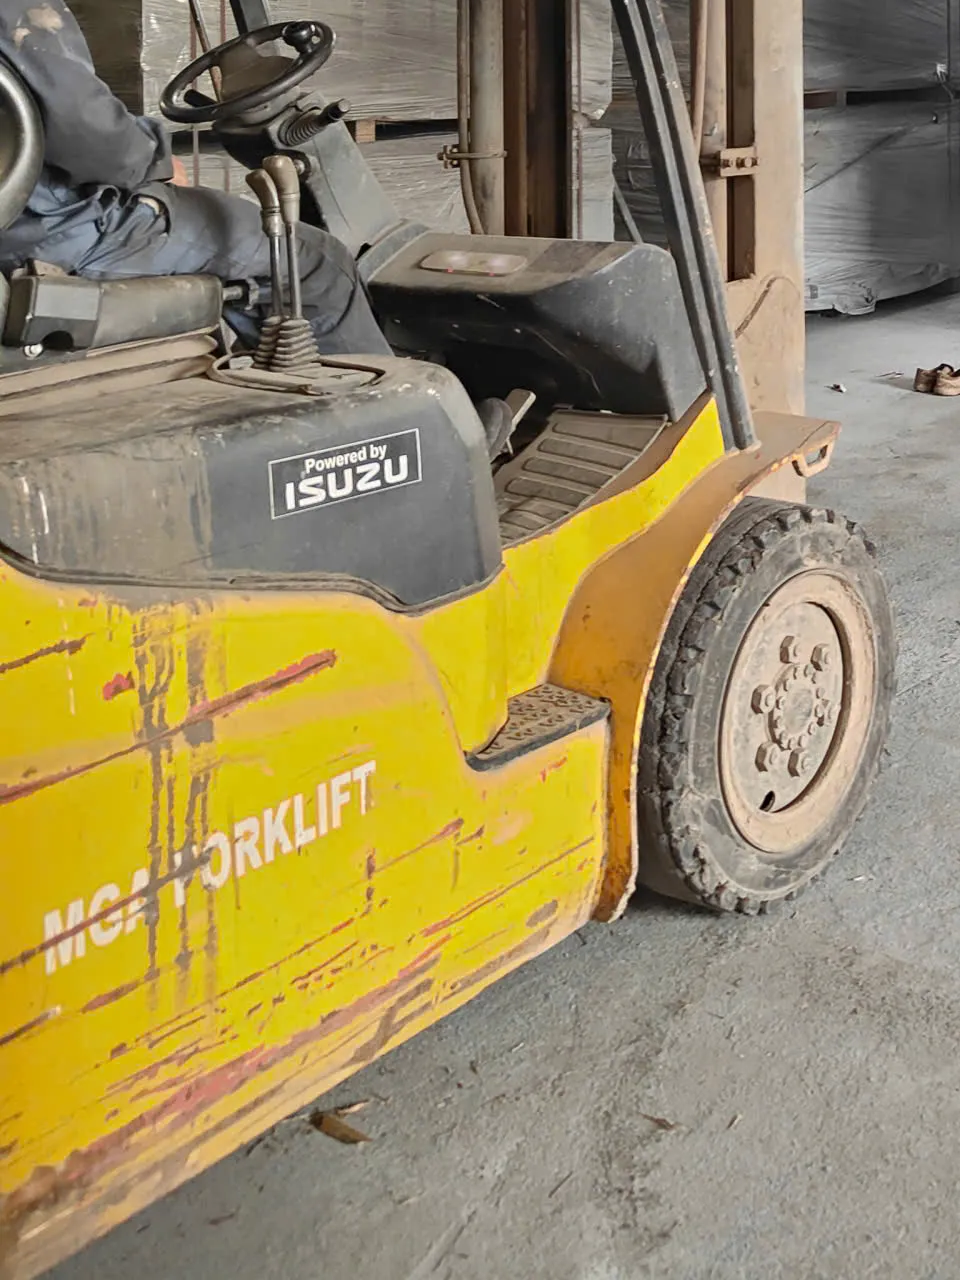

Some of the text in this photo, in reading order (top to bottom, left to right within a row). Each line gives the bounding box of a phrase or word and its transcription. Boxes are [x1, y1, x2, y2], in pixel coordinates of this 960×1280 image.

[304, 443, 388, 473] Powered by
[285, 454, 409, 510] ISUZU
